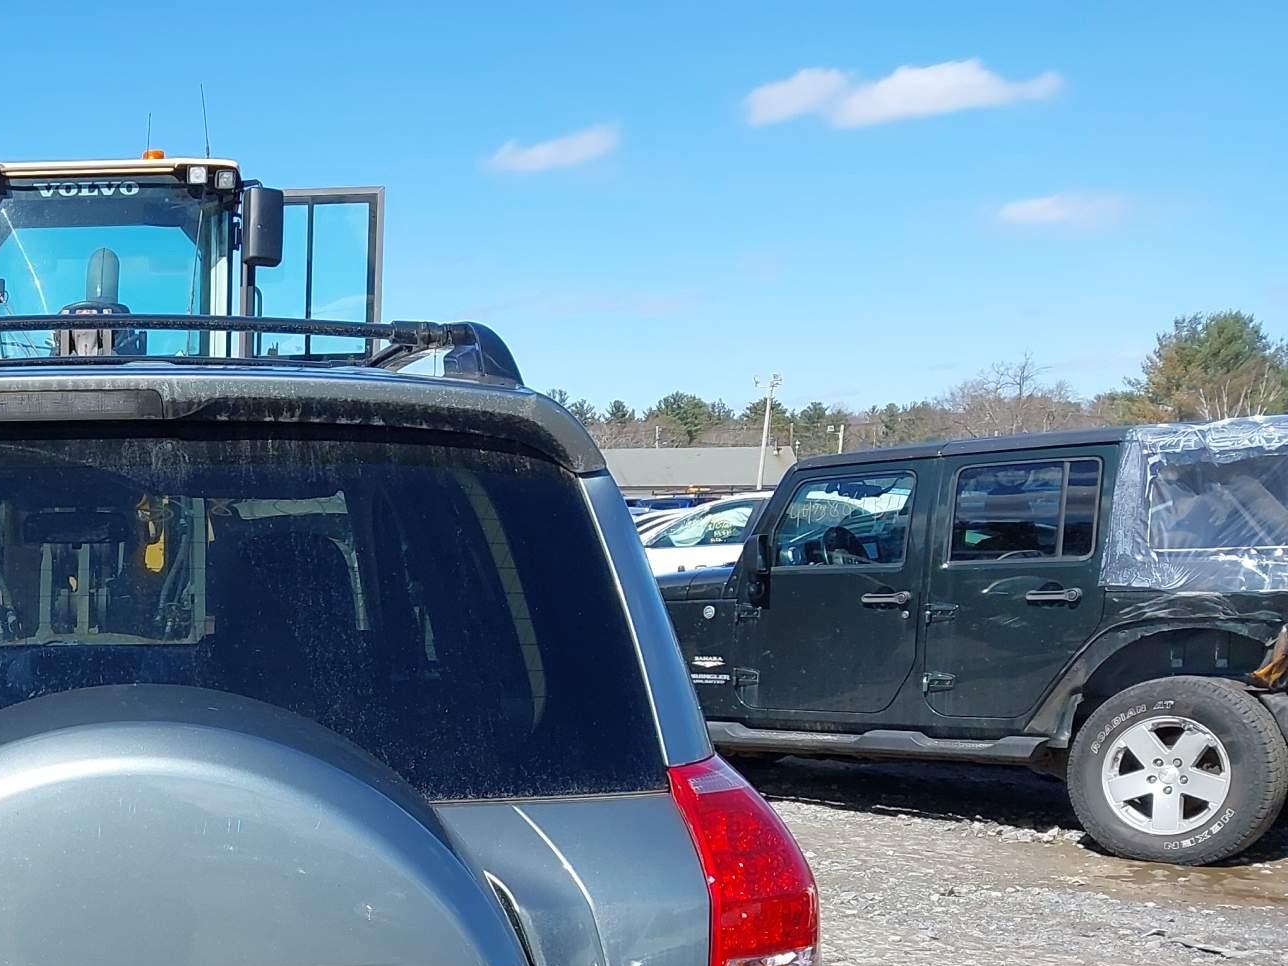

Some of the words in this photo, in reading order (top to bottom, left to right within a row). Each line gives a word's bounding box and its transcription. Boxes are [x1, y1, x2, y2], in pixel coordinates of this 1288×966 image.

[33, 180, 140, 198] VOLVO
[1090, 702, 1148, 755] ROADIAN
[1163, 807, 1236, 851] NEXEN
